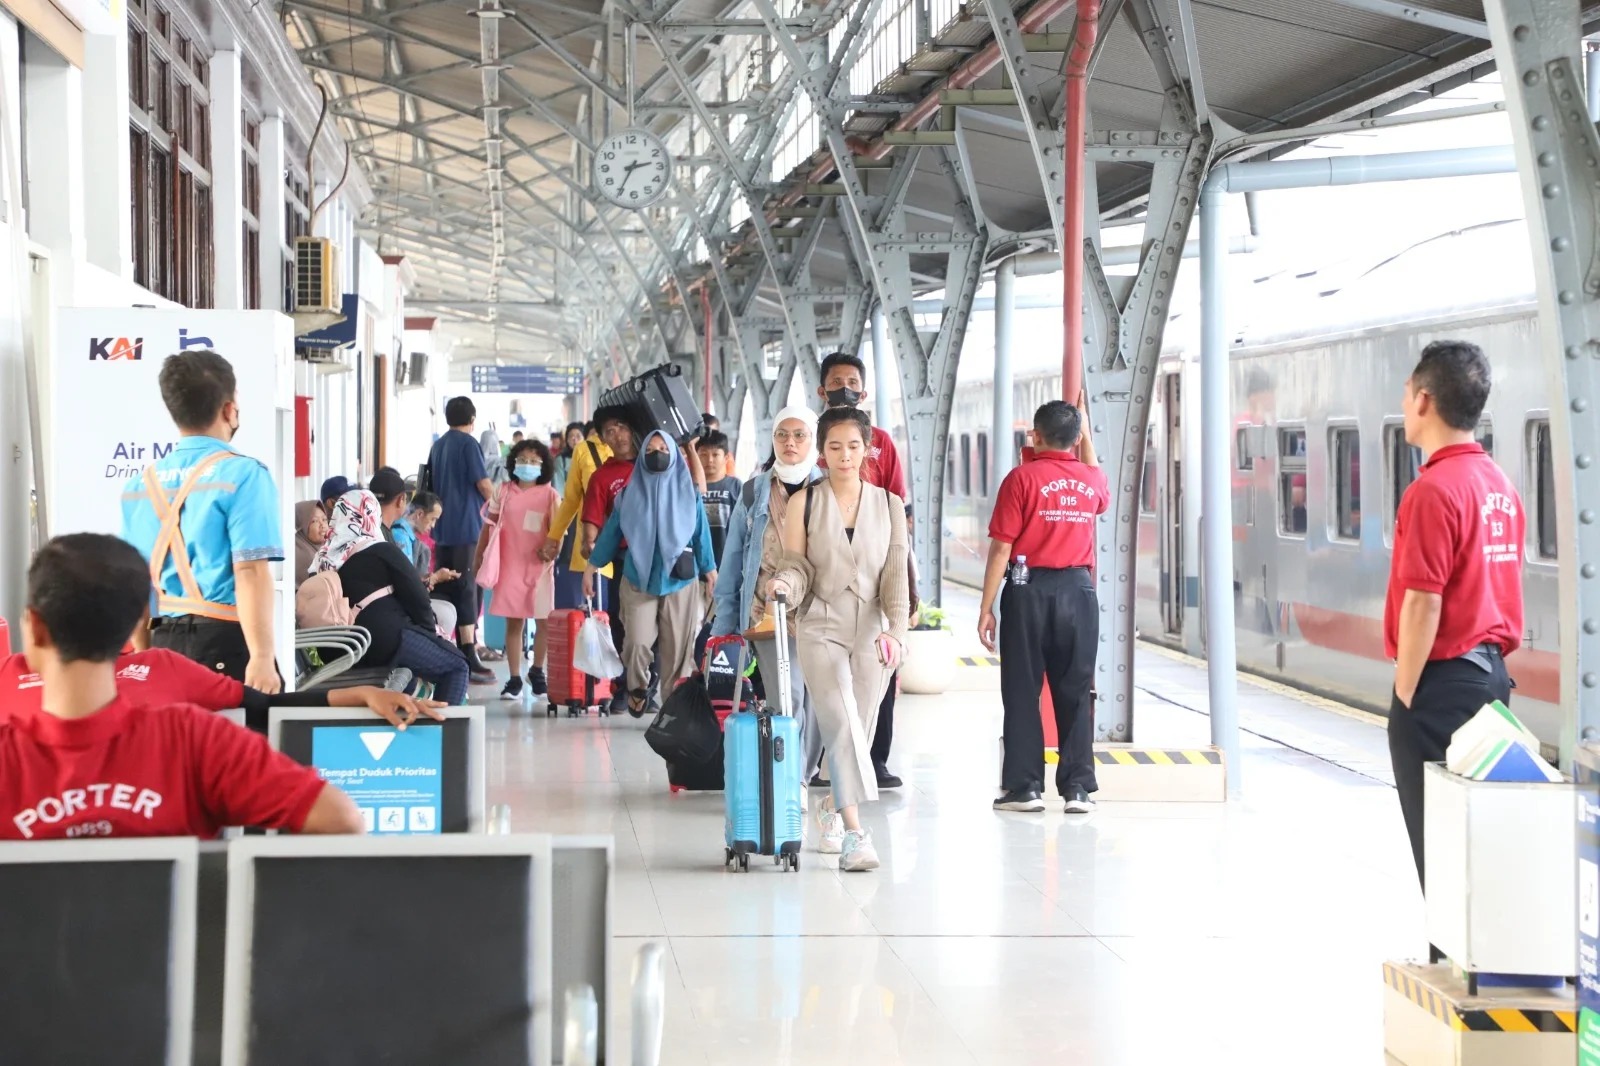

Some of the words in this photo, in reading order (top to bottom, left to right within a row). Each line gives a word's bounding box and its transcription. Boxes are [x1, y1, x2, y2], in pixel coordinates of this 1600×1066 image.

[625, 135, 637, 144] 12
[643, 138, 647, 147] 1
[612, 141, 622, 150] 11
[603, 152, 615, 160] 10
[651, 149, 660, 158] 2
[600, 164, 610, 173] 9
[655, 162, 664, 170] 3
[605, 177, 614, 186] 8
[651, 175, 661, 183] 4
[630, 190, 638, 199] 6
[643, 185, 652, 195] 5
[89, 337, 144, 360] KAI
[112, 442, 146, 460] Air
[152, 442, 179, 459] M
[1040, 479, 1095, 500] PORTER
[702, 490, 730, 499] ATTLE
[1060, 496, 1078, 506] 015
[1480, 492, 1517, 525] PRTER
[710, 666, 734, 675] eebok
[319, 767, 358, 779] Tempat
[360, 767, 393, 777] Duduk
[395, 766, 437, 777] Prioritas
[13, 783, 163, 839] PORTER
